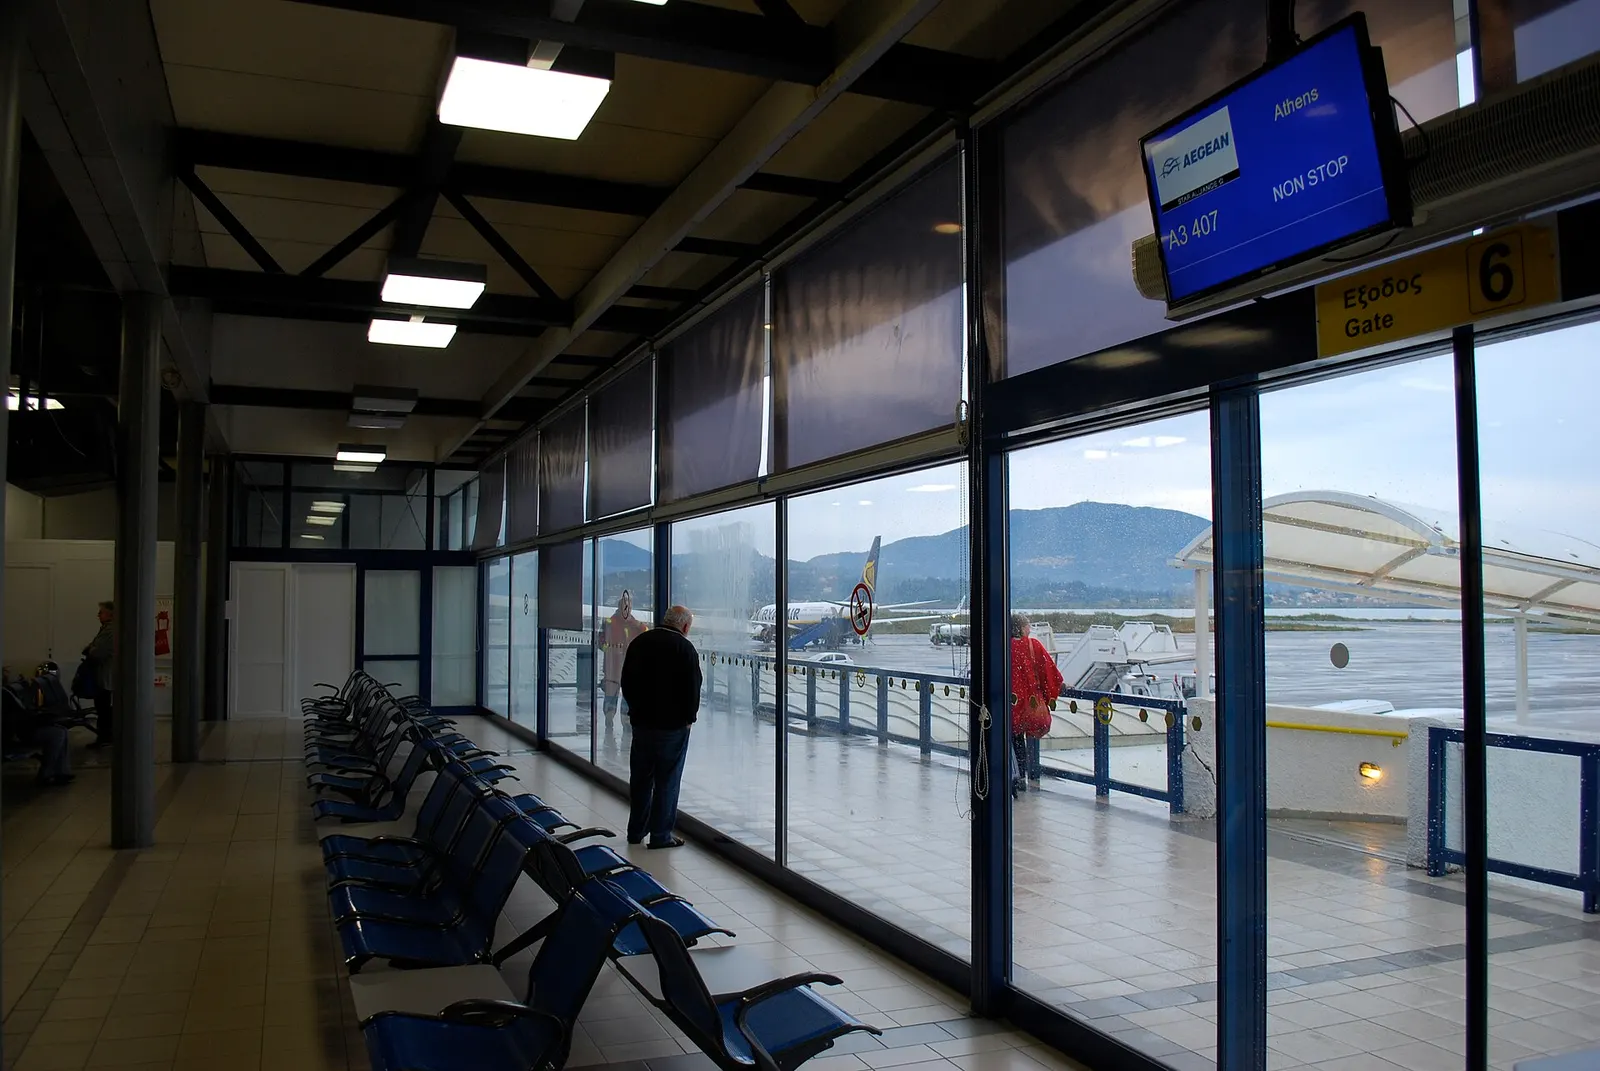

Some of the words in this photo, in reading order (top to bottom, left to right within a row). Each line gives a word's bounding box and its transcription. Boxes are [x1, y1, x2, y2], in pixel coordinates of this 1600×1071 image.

[1275, 88, 1319, 122] Athens
[1183, 132, 1229, 168] AEGEAN
[1177, 191, 1192, 205] STAR
[1191, 181, 1218, 199] ALLIANCE
[1272, 175, 1305, 202] NON
[1307, 155, 1348, 186] STOP
[1169, 224, 1188, 250] A3
[1192, 209, 1218, 238] 407
[1479, 243, 1513, 302] 6
[1344, 274, 1422, 310] Εξοδος
[1345, 312, 1394, 338] Gate
[762, 608, 800, 620] RYIR
